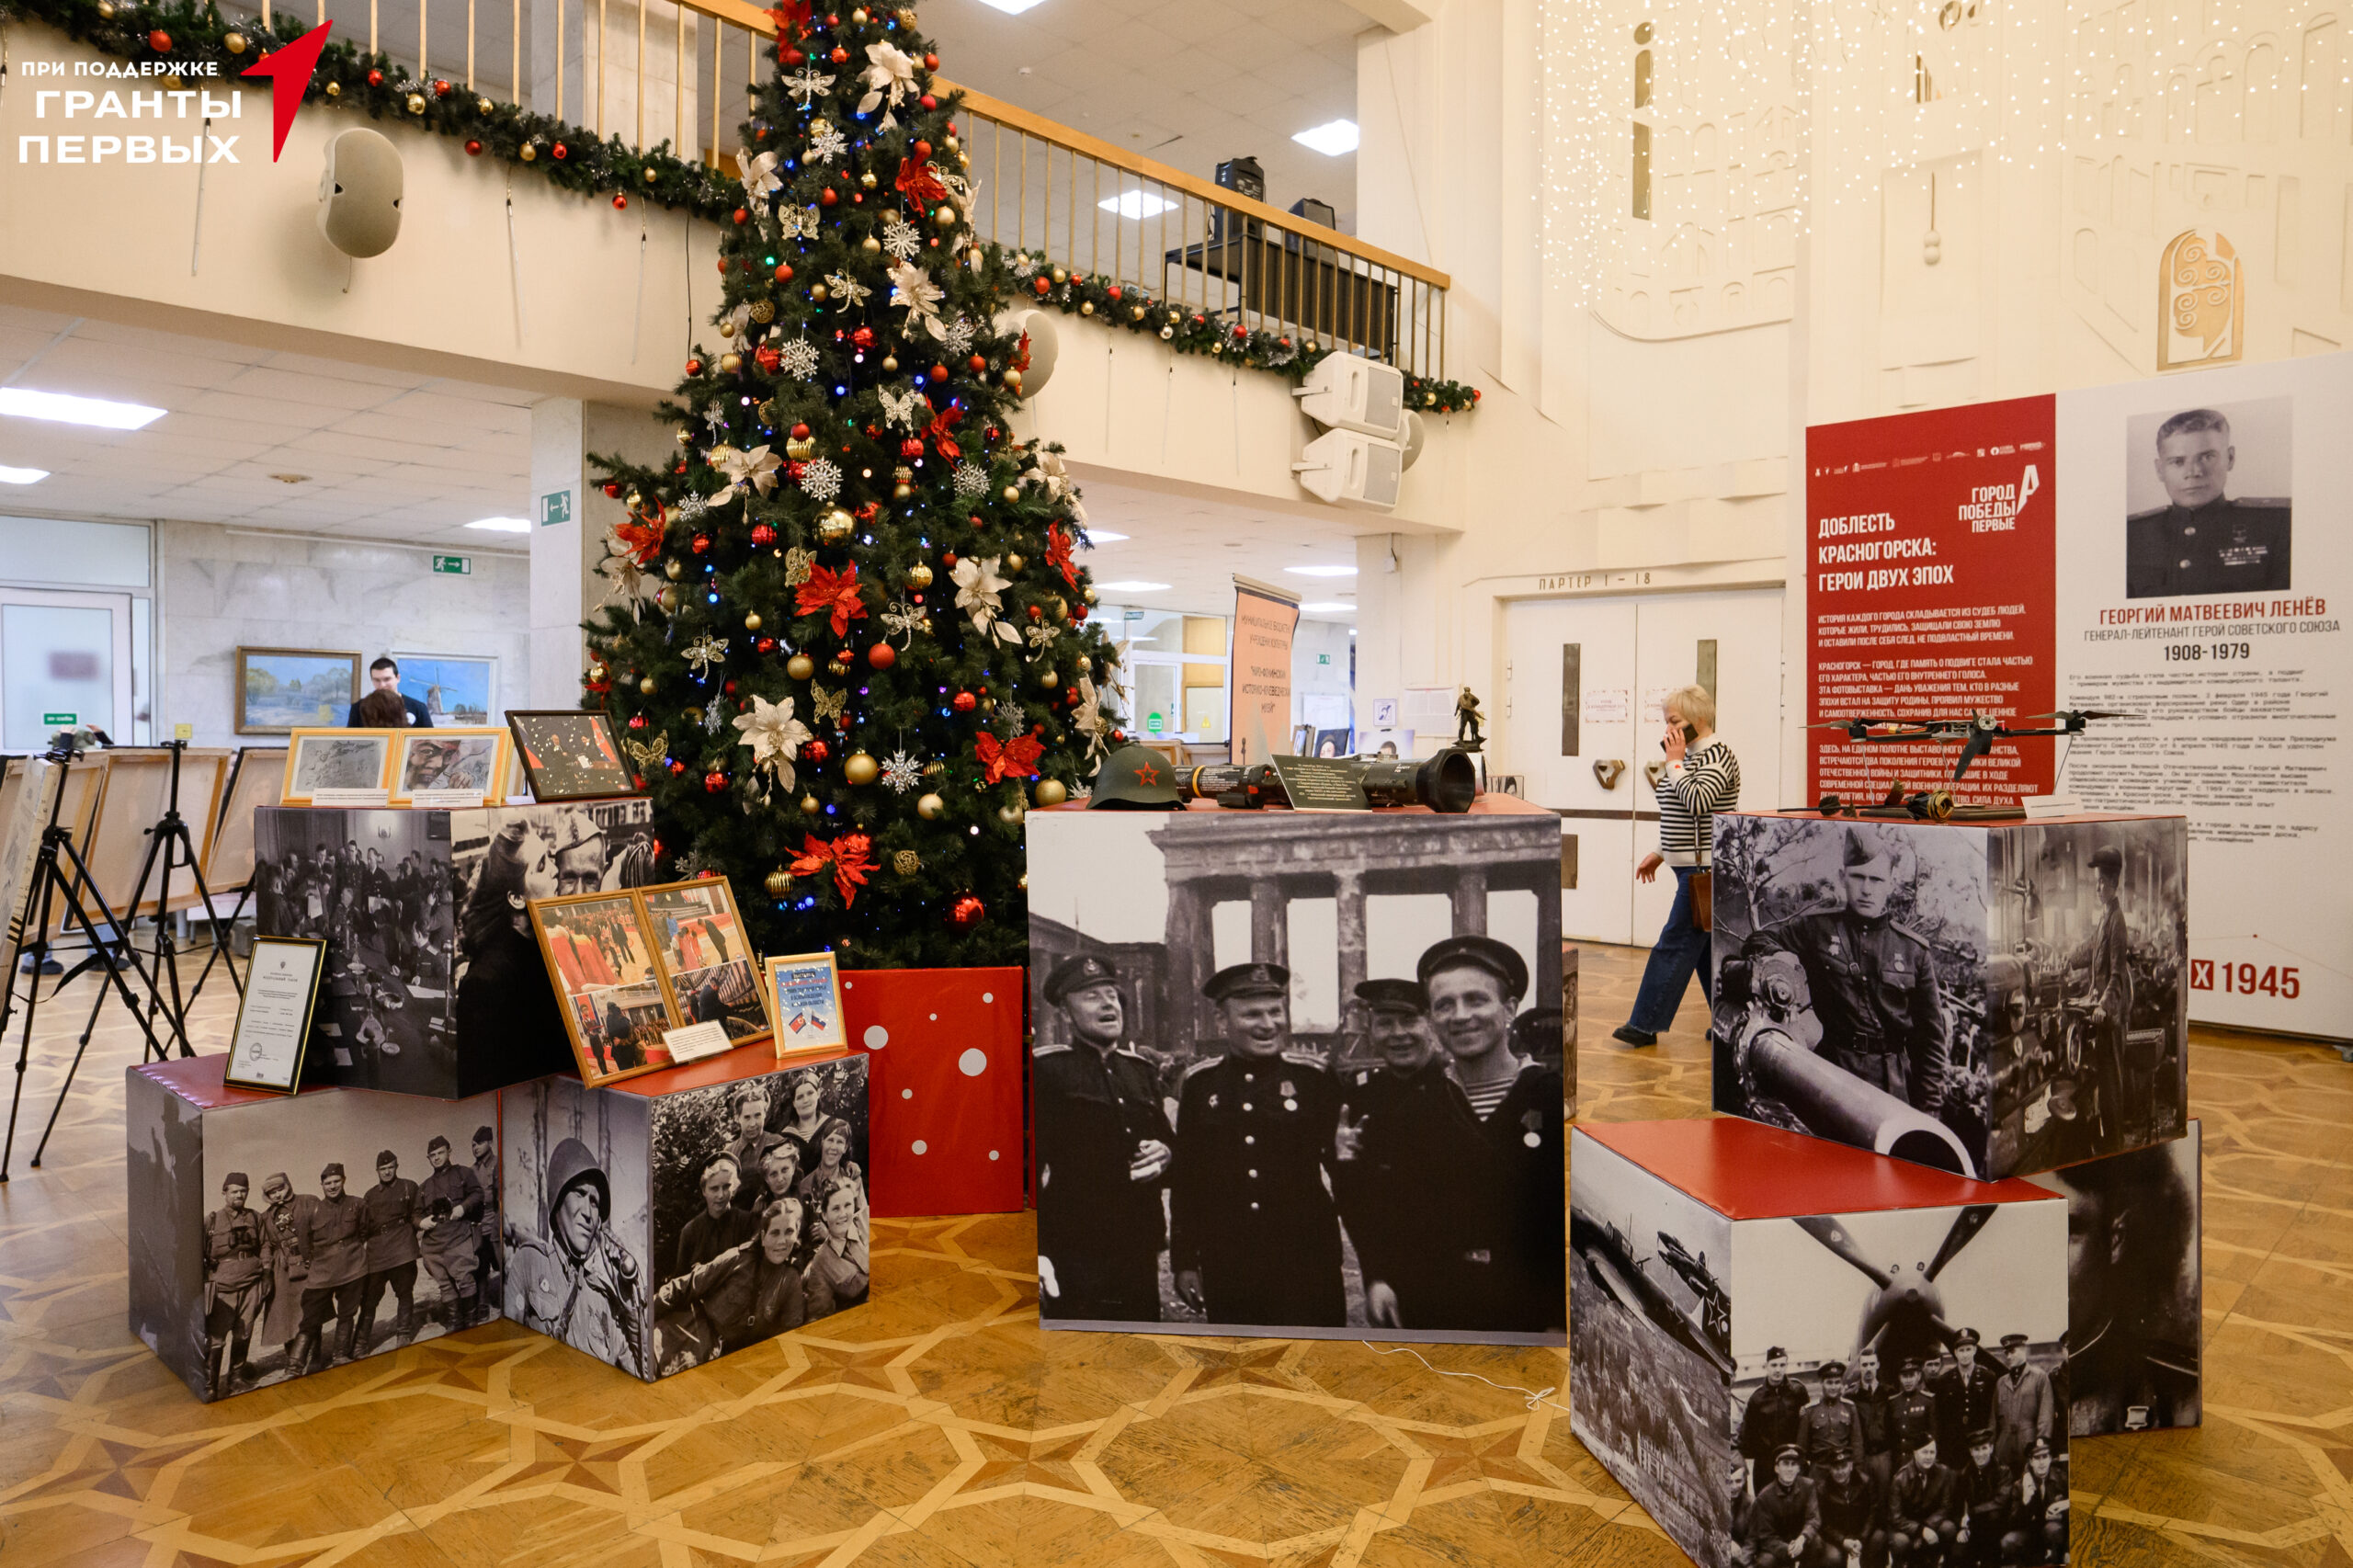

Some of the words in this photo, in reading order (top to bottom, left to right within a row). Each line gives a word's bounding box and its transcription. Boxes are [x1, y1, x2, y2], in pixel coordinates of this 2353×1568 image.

[1972, 483, 2015, 504] ГОРОД
[1958, 501, 2016, 521] ПОБЕДЫ
[1818, 512, 1895, 539] ДОБЛЕСТЬ
[1972, 517, 2016, 533] ПЕРВЫЕ
[1818, 537, 1937, 564] КРАСНОГОРСКА:
[1539, 575, 1592, 591] ПАРТЕР
[1818, 572, 1863, 592] ГЕРОИ
[1867, 567, 1909, 591] ДВУХ
[1912, 564, 1954, 586] ЭПОХ
[1819, 614, 1845, 624] ИСТОРИЯ
[1847, 612, 1878, 622] КАЖДОГО
[1880, 611, 1904, 620] ГОРОДА
[1972, 607, 1995, 617] СУДЕБ
[2099, 604, 2165, 625] ГЕОРГИЙ
[2169, 601, 2265, 621] МАТВЕЕВИЧ
[2270, 597, 2325, 618] ЛЕНЁВ
[1819, 626, 1846, 635] КОТОРЫЕ
[1912, 621, 1951, 631] ЗАЩИЩАЛИ
[1953, 620, 1972, 630] СВОЮ
[1974, 619, 2000, 629] ЗЕМЛЮ
[2084, 626, 2189, 642] ГЕНЕРАЛ-ЛЕЙТЕНАНТ
[2193, 623, 2225, 637] ГЕРОЙ
[2228, 621, 2296, 636] СОВЕТСКОГО
[2299, 619, 2340, 633] СОЮЗА
[1824, 638, 1856, 647] ОСТАВИЛИ
[1858, 637, 1877, 645] ПОСЛЕ
[1879, 636, 1894, 644] СЕБЯ
[2164, 642, 2250, 661] 1908-1979
[1897, 660, 1908, 668] ГДЕ
[1911, 659, 1937, 668] ПАМЯТЬ
[1945, 658, 1975, 667] ПОДВИГЕ
[1978, 657, 2001, 666] СТАЛА
[2003, 656, 2032, 665] ЧАСТЬЮ
[1819, 674, 1830, 682] ЕГО
[1870, 673, 1895, 681] ЧАСТЬЮ
[1898, 672, 1909, 680] ЕГО
[1819, 686, 1830, 694] ЭТА
[1894, 684, 1912, 693] ДАНЬ
[1915, 684, 1950, 693] УВАЖЕНИЯ
[1970, 683, 1983, 692] КТО
[1991, 682, 2018, 691] РАЗНЫЕ
[1819, 698, 1838, 706] ЭПОХИ
[1840, 698, 1860, 706] ВСТАЛ
[1872, 697, 1898, 705] ЗАЩИТУ
[1931, 696, 1962, 705] ПРОЯВИЛ
[1964, 695, 2003, 704] МУЖЕСТВО
[1897, 709, 1931, 717] СОХРАНИВ
[1933, 709, 1948, 717] ДЛЯ
[1949, 709, 1962, 717] НАС
[1964, 708, 1987, 717] САОЕ
[1989, 708, 2016, 717] ЦЕННОЕ
[1852, 745, 1878, 755] ЕДИНОМ
[1880, 745, 1908, 755] ПОЛОТНЕ
[1963, 745, 2018, 755] АНСТВА,
[1866, 757, 1878, 766] ДВА
[1880, 757, 1917, 767] ПОКОЛЕНИЯ
[1947, 757, 1986, 767] УЧАНИКИ
[1988, 758, 2021, 767] ВЕЛИКОЙ
[1871, 769, 1893, 778] ВОЙНЫ
[1989, 770, 2007, 780] ХОДЕ
[1865, 781, 1911, 790] СПЕЦИАЛОЙ
[1913, 782, 1941, 791] ВОЕННОЙ
[1994, 783, 2038, 793] РАЗДЕЛЯЮТ
[1972, 795, 1992, 804] СИЛА
[1994, 796, 2014, 805] ДУХА
[2222, 961, 2300, 1000] 1945
